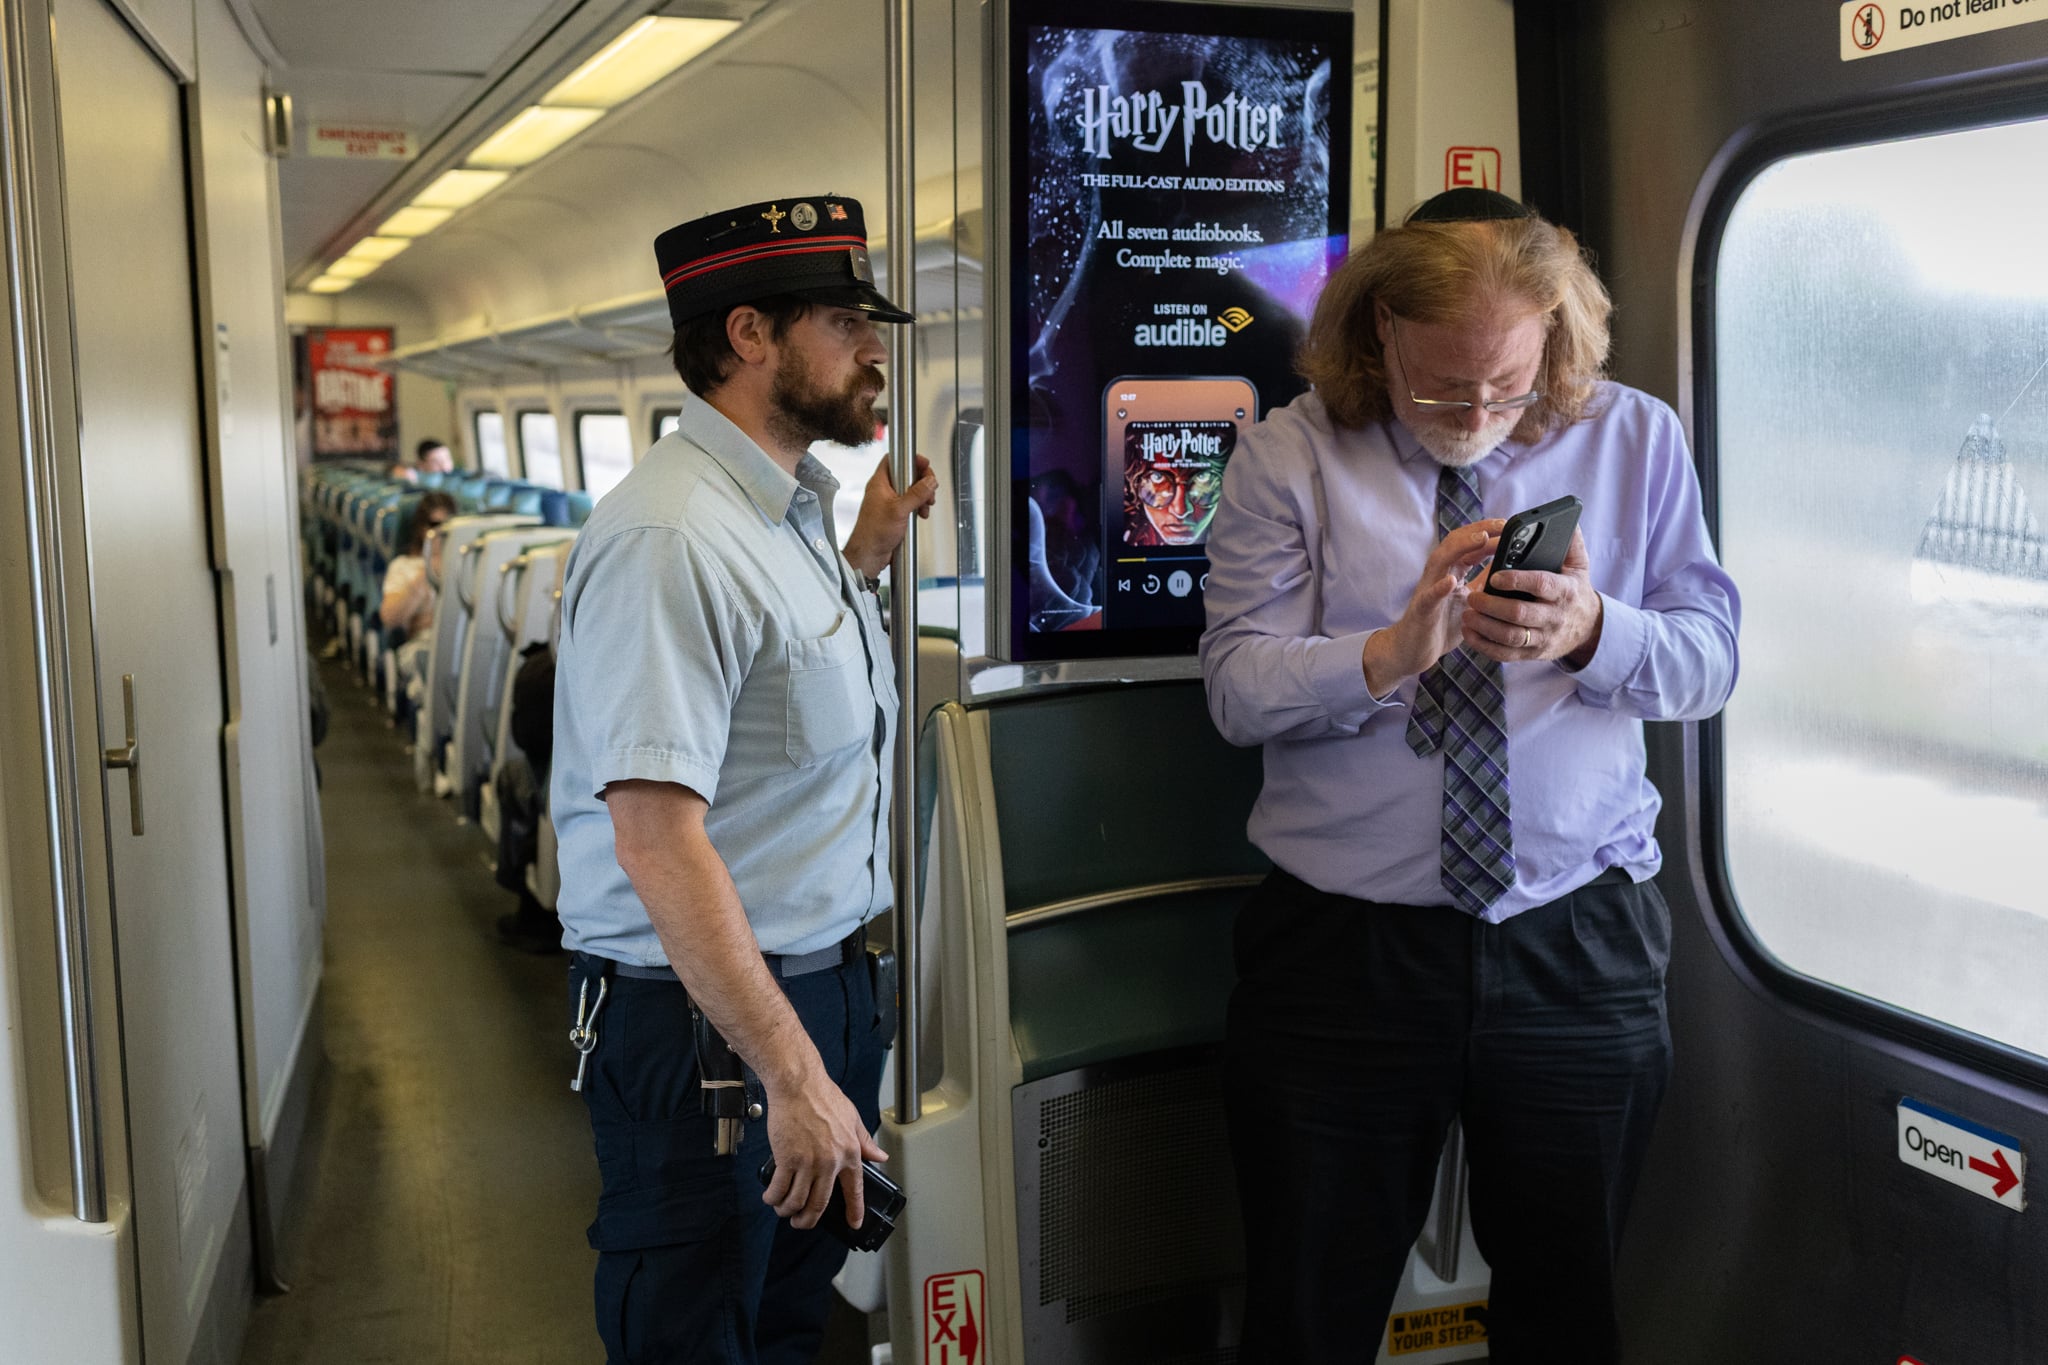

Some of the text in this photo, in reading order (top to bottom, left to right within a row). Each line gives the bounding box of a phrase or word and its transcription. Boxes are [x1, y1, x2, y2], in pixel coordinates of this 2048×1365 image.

[1900, 8, 1925, 30] Do
[1931, 0, 1961, 23] not
[1076, 81, 1284, 168] Harry Potter
[1081, 174, 1285, 193] THE FULL-CAST AUDIO EDITIONS
[1097, 220, 1264, 243] All seven audiobooks.
[1116, 248, 1244, 276] Complete magic.
[1153, 303, 1208, 315] LISTEN ON
[1134, 318, 1227, 347] audible
[1140, 429, 1222, 462] Harry Potter
[1905, 1126, 1964, 1170] Open
[932, 1278, 957, 1365] EXI
[1409, 1309, 1460, 1331] WATCH
[1394, 1325, 1474, 1351] YOUR STEP
